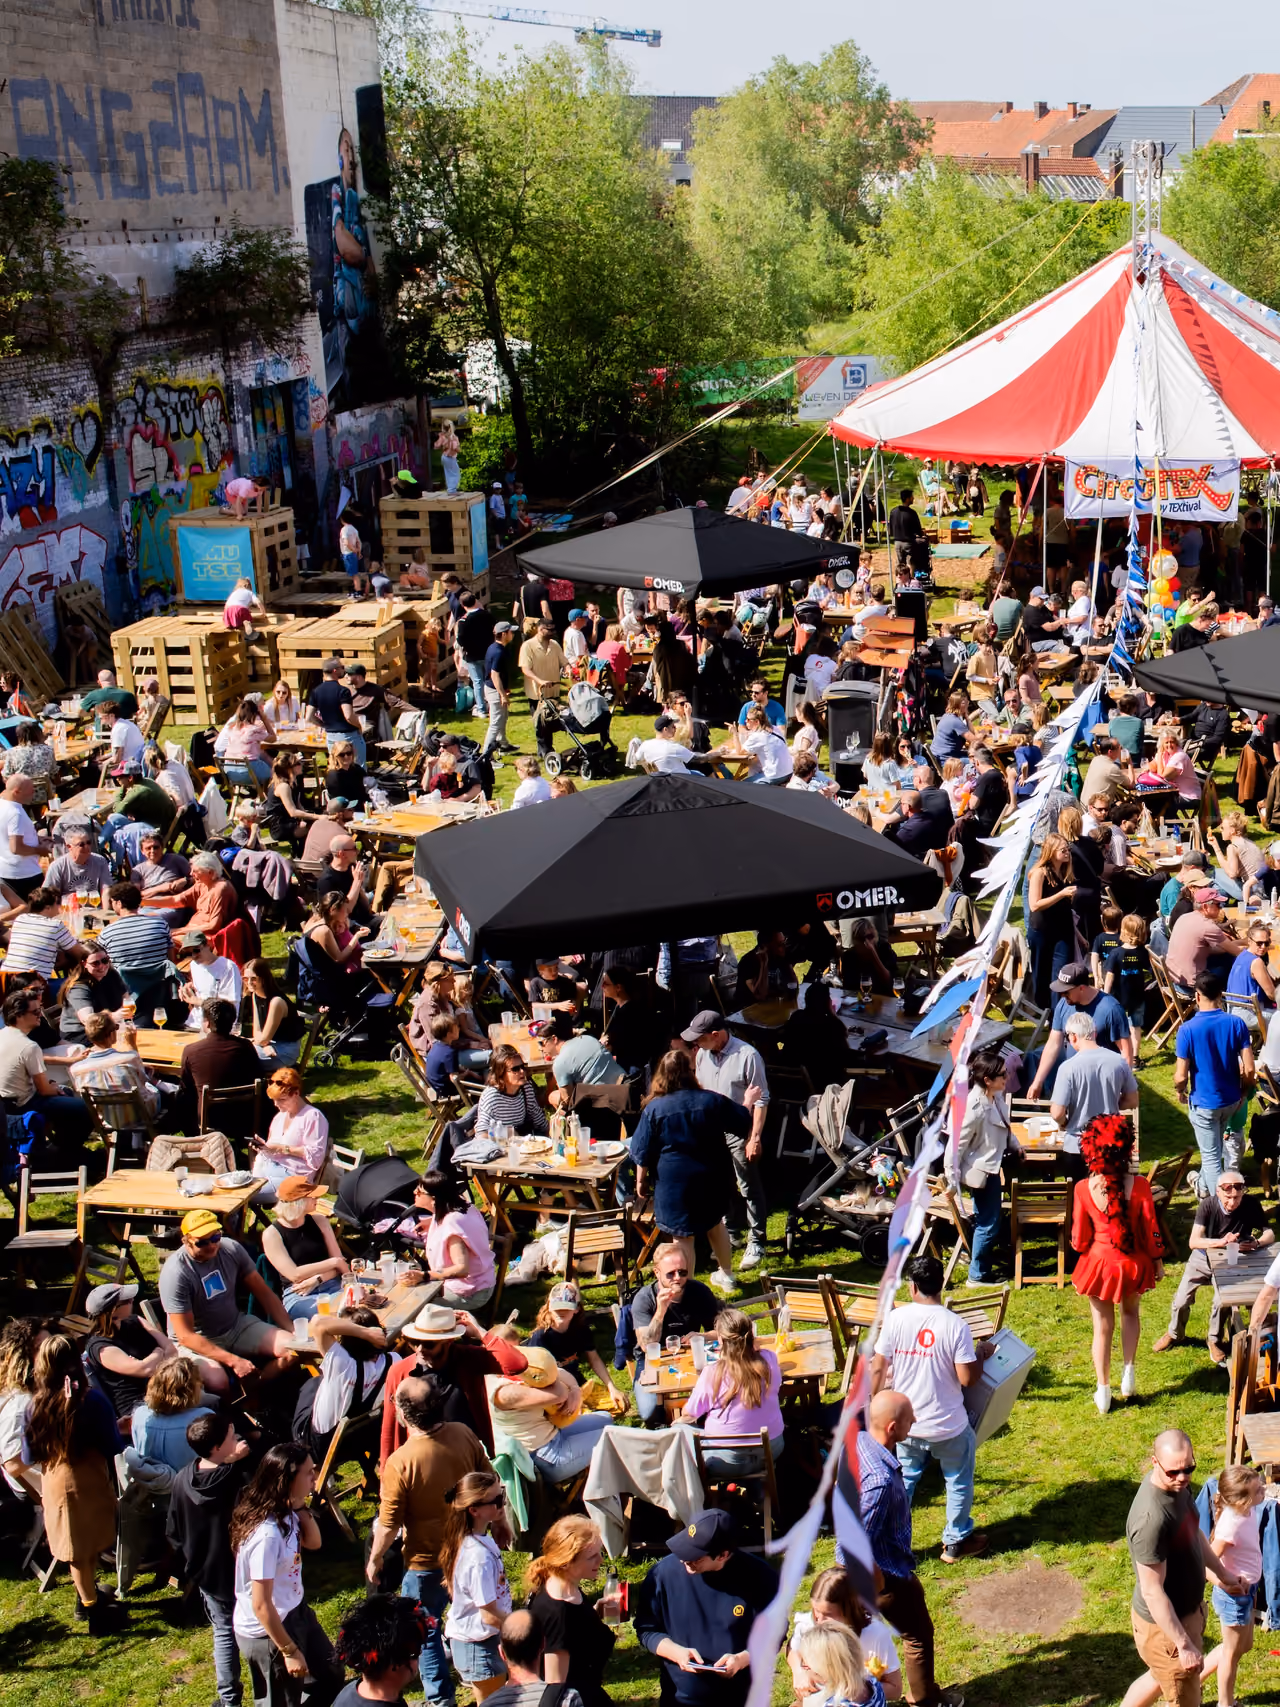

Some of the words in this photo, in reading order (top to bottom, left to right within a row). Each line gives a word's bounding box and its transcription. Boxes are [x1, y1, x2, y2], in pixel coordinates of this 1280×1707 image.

[1169, 500, 1202, 513] TEXtival
[828, 556, 851, 567] OMER.
[192, 562, 242, 577] TSE
[653, 577, 685, 593] OMER.
[836, 886, 905, 910] OMER.
